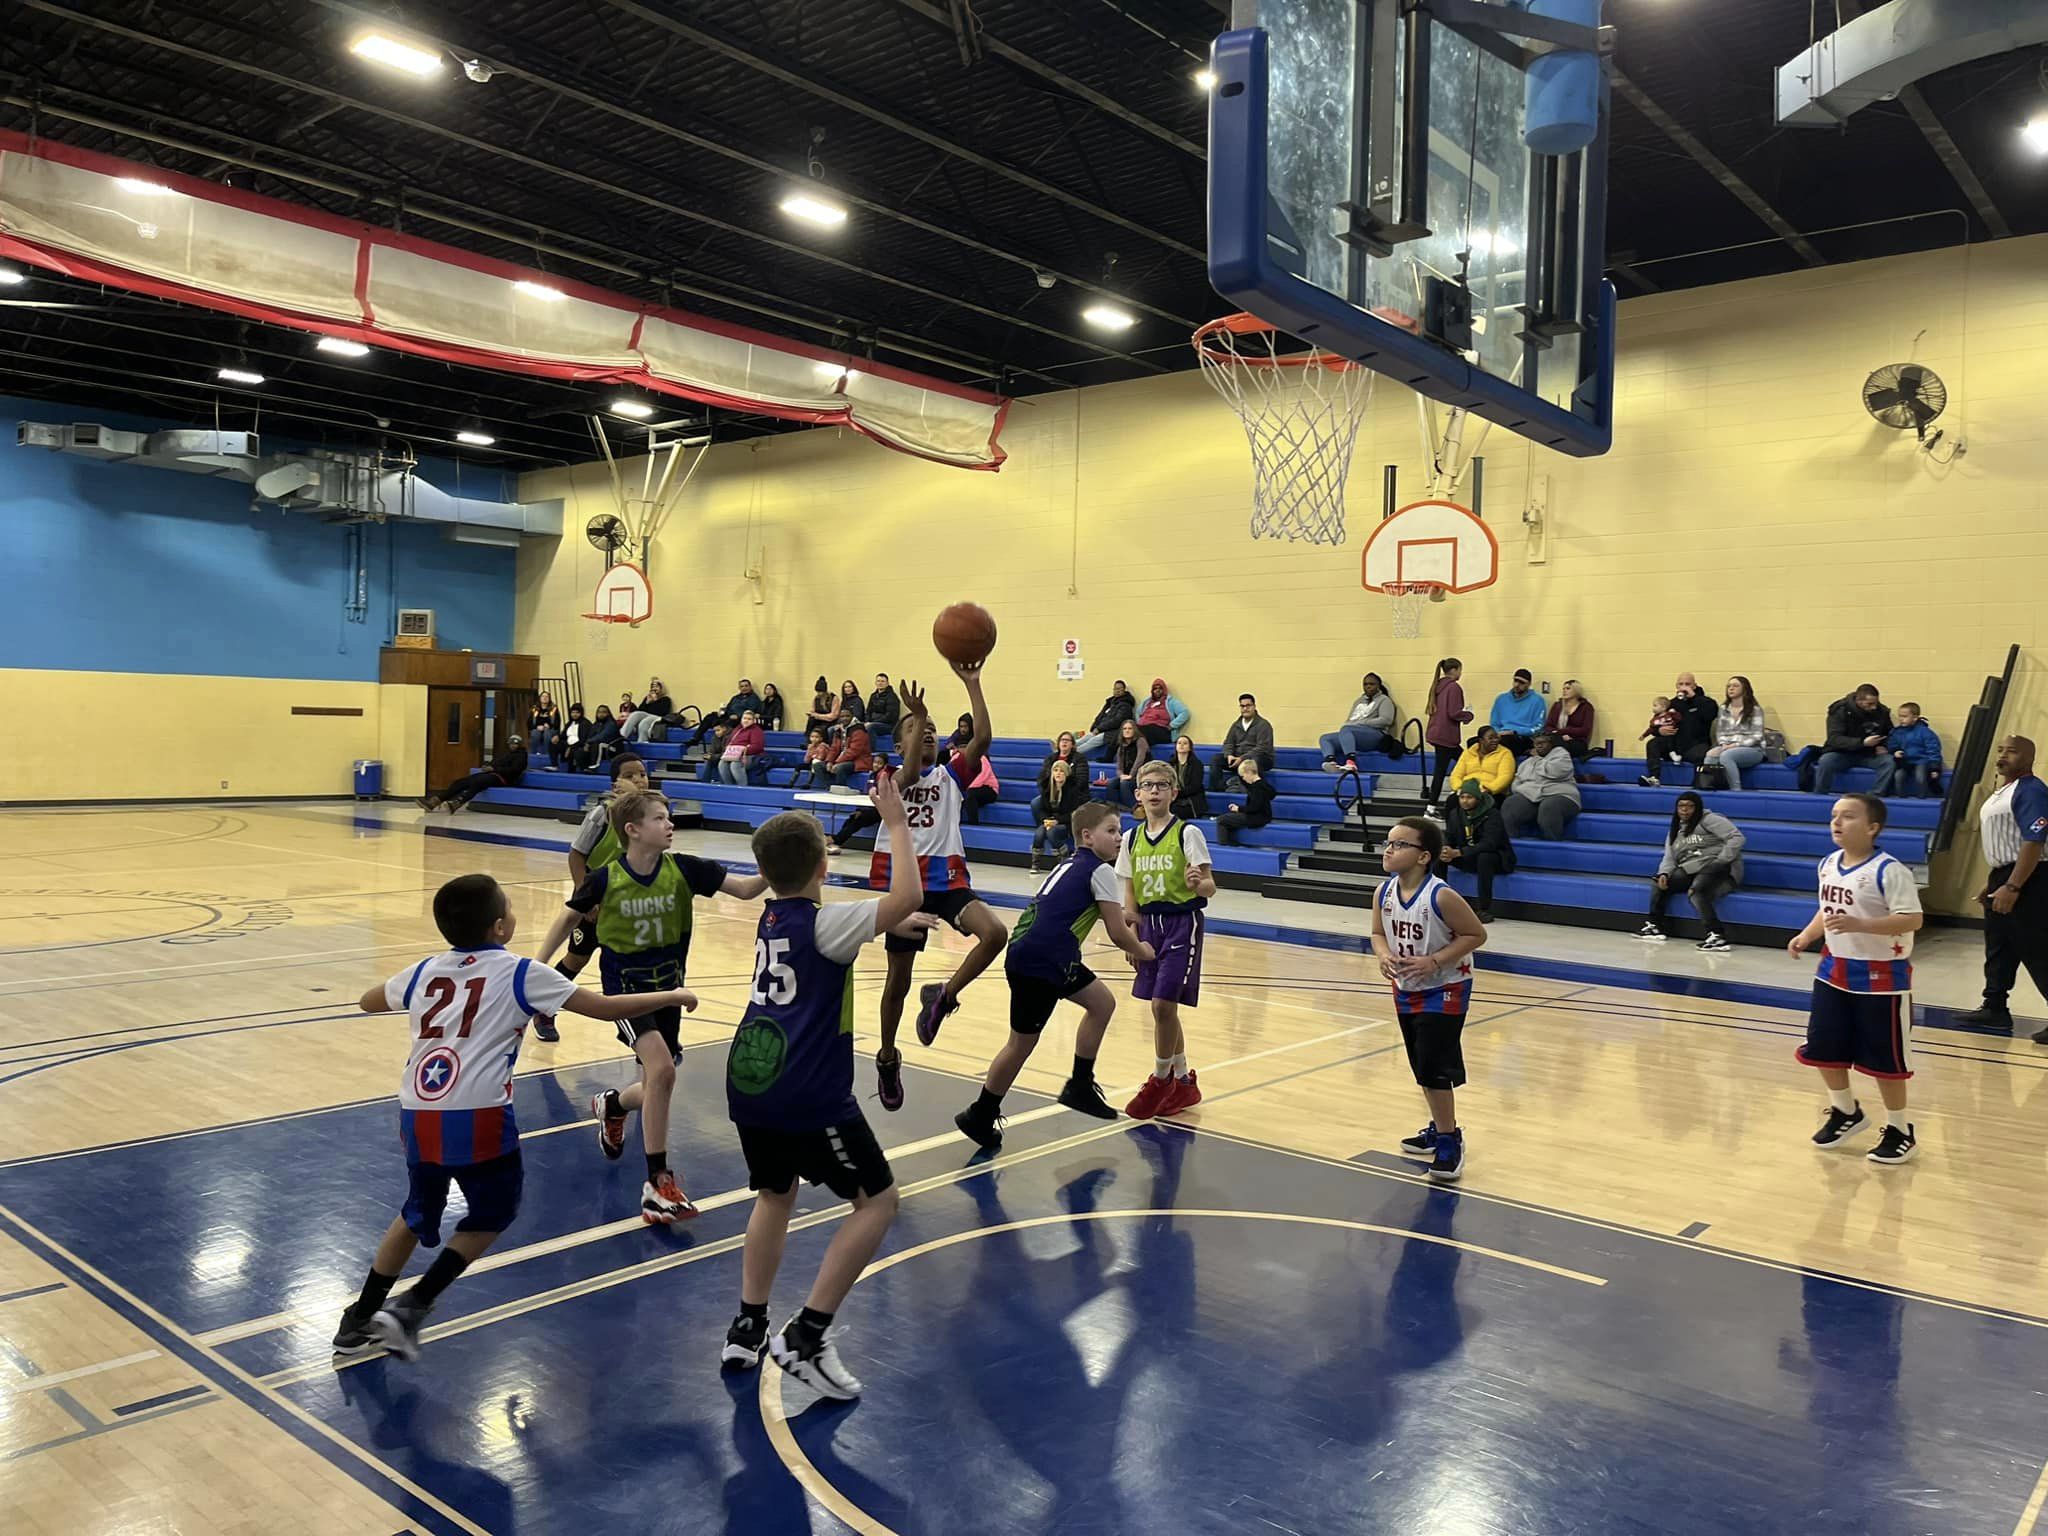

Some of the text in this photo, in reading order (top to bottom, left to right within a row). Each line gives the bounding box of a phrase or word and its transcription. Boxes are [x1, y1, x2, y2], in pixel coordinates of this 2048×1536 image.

[902, 785, 940, 804] NETS
[907, 805, 935, 828] 23
[1135, 854, 1173, 873] BUCKS
[1142, 873, 1166, 897] 24
[1821, 884, 1853, 906] NETS
[620, 894, 676, 917] BUCKS
[633, 917, 664, 945] 21
[752, 937, 797, 1006] 25
[418, 977, 488, 1040] 21
